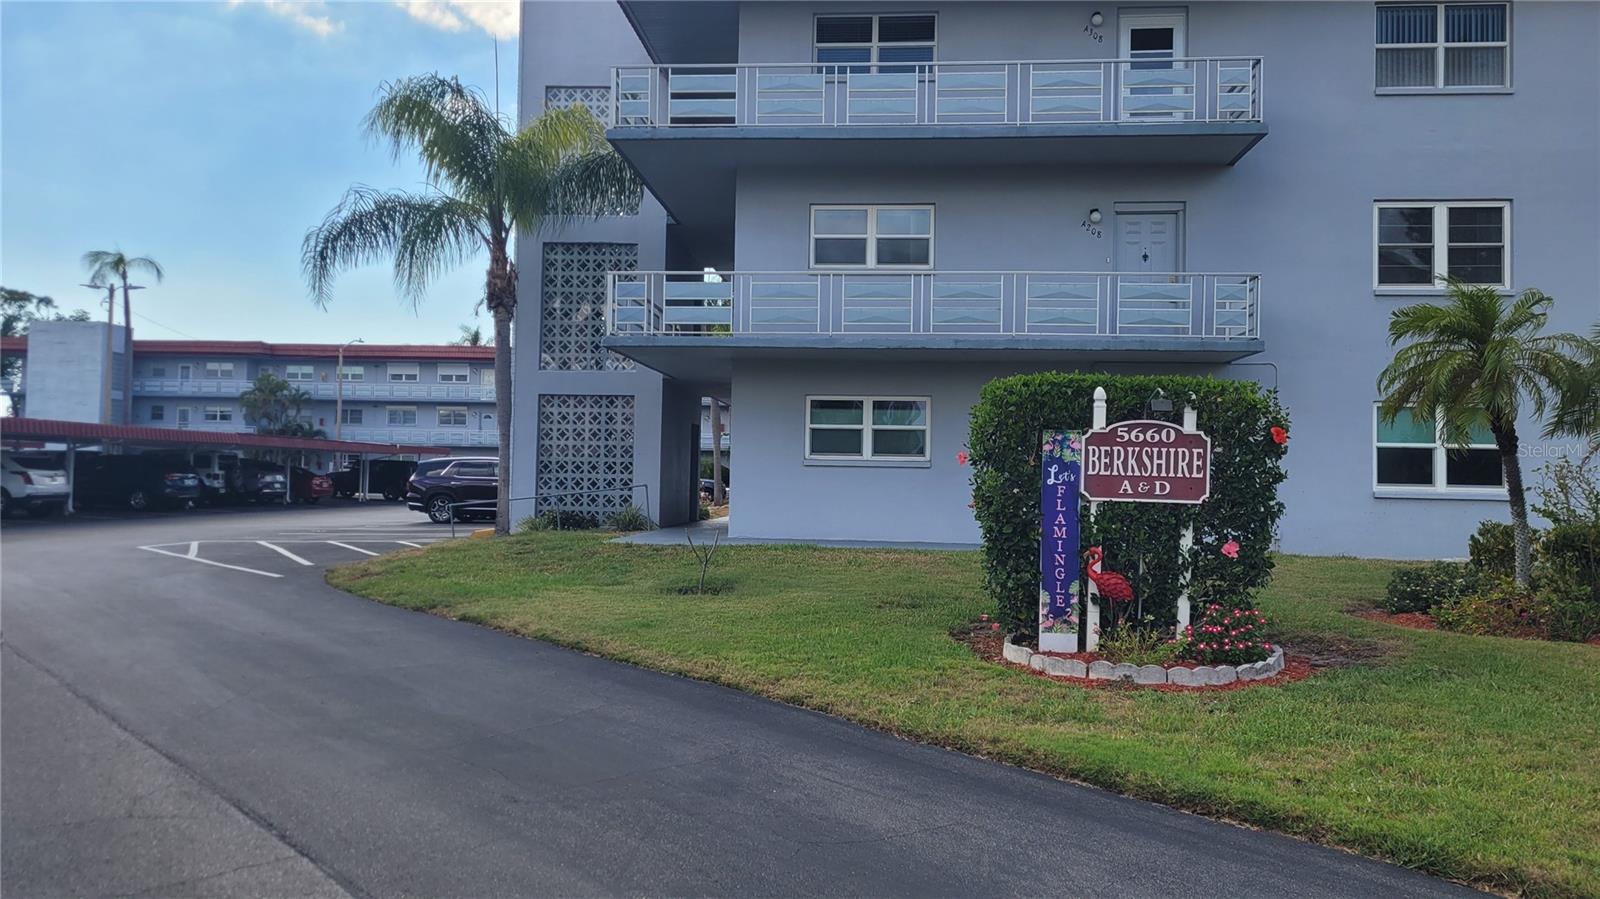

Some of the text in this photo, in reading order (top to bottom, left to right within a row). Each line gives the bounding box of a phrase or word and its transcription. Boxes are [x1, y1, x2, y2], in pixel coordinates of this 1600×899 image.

[1081, 220, 1103, 239] A208
[1115, 428, 1176, 443] 5660
[1087, 446, 1204, 478] BERKSHIRE
[1047, 464, 1076, 485] Let's
[1119, 481, 1171, 495] A & D
[1053, 486, 1067, 608] FLAMINGLE
